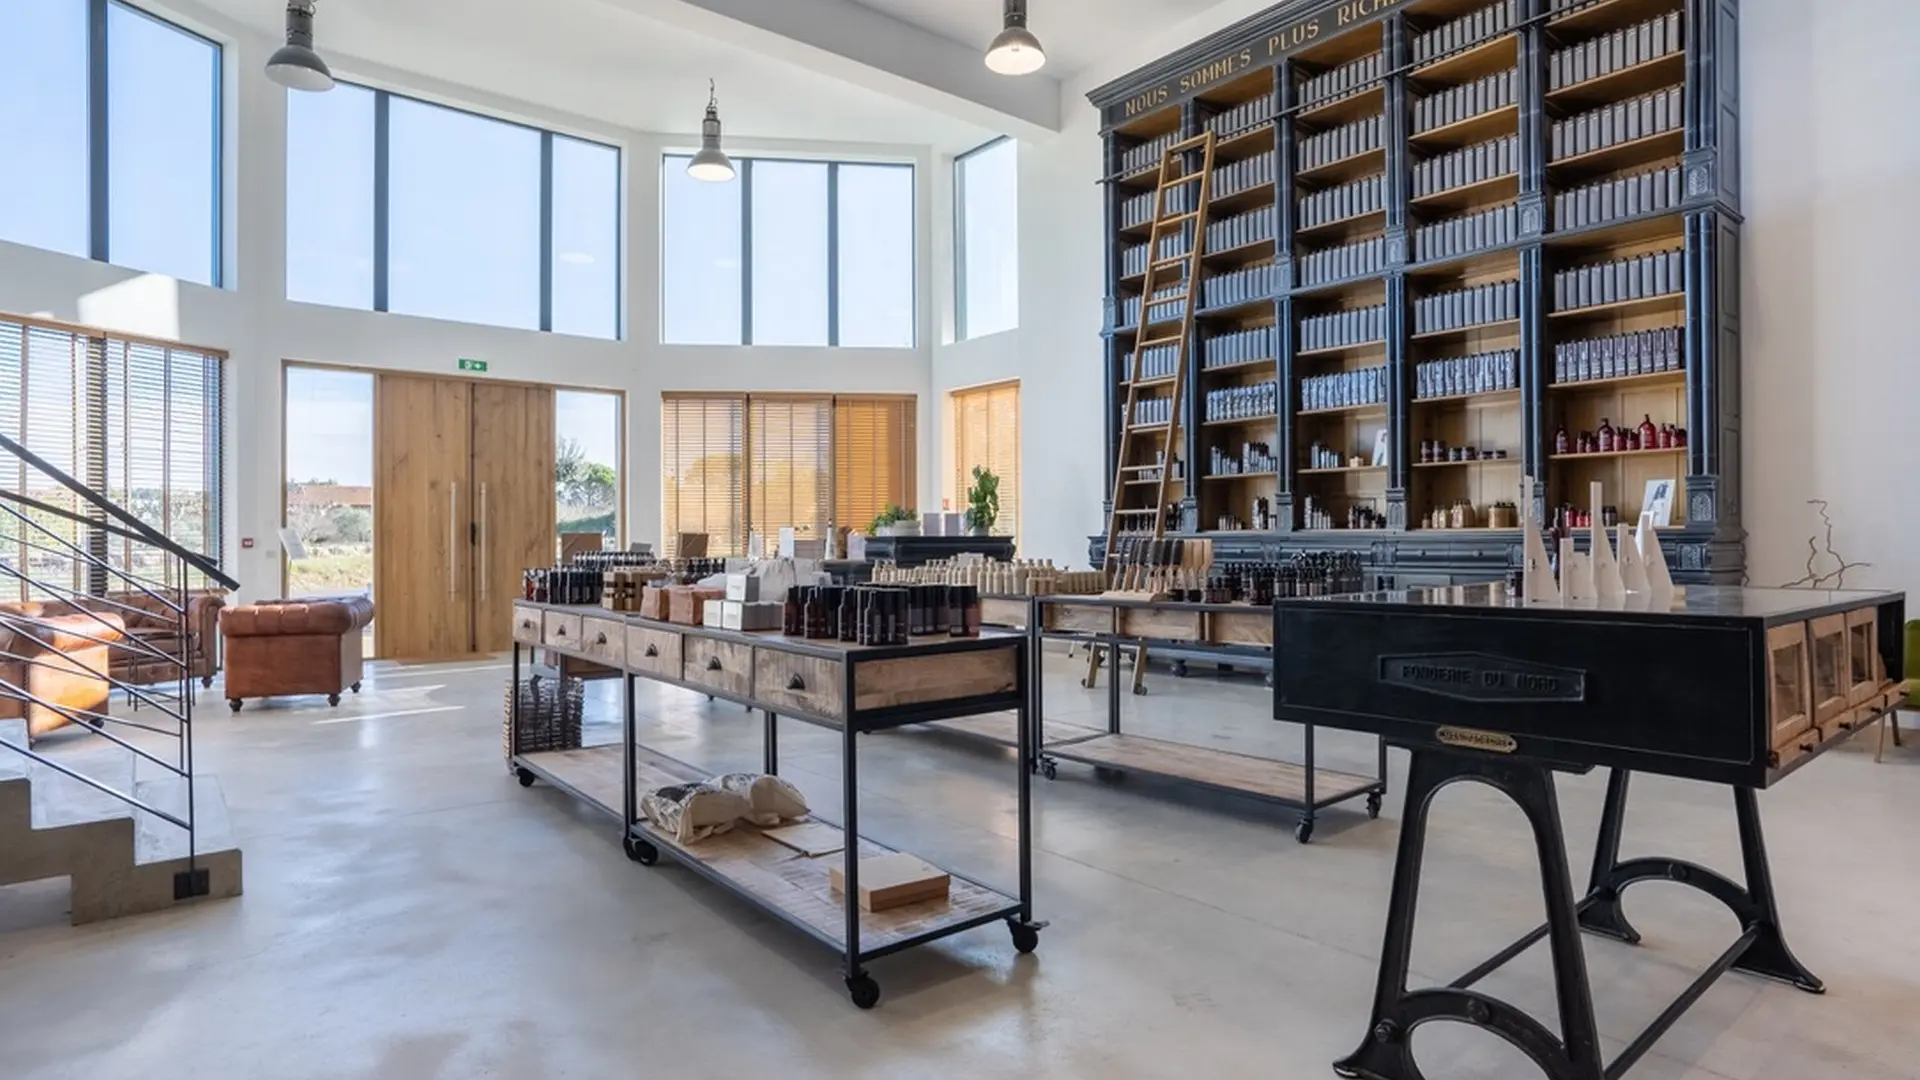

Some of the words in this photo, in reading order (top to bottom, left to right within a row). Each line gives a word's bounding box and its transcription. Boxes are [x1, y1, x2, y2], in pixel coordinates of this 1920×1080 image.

[1125, 85, 1168, 117] NOUS
[1180, 48, 1251, 94] SOMMES
[1268, 18, 1319, 56] PLUS
[1401, 663, 1473, 685] FONDERIE
[1483, 670, 1504, 686] DU
[1514, 673, 1559, 692] NORD
